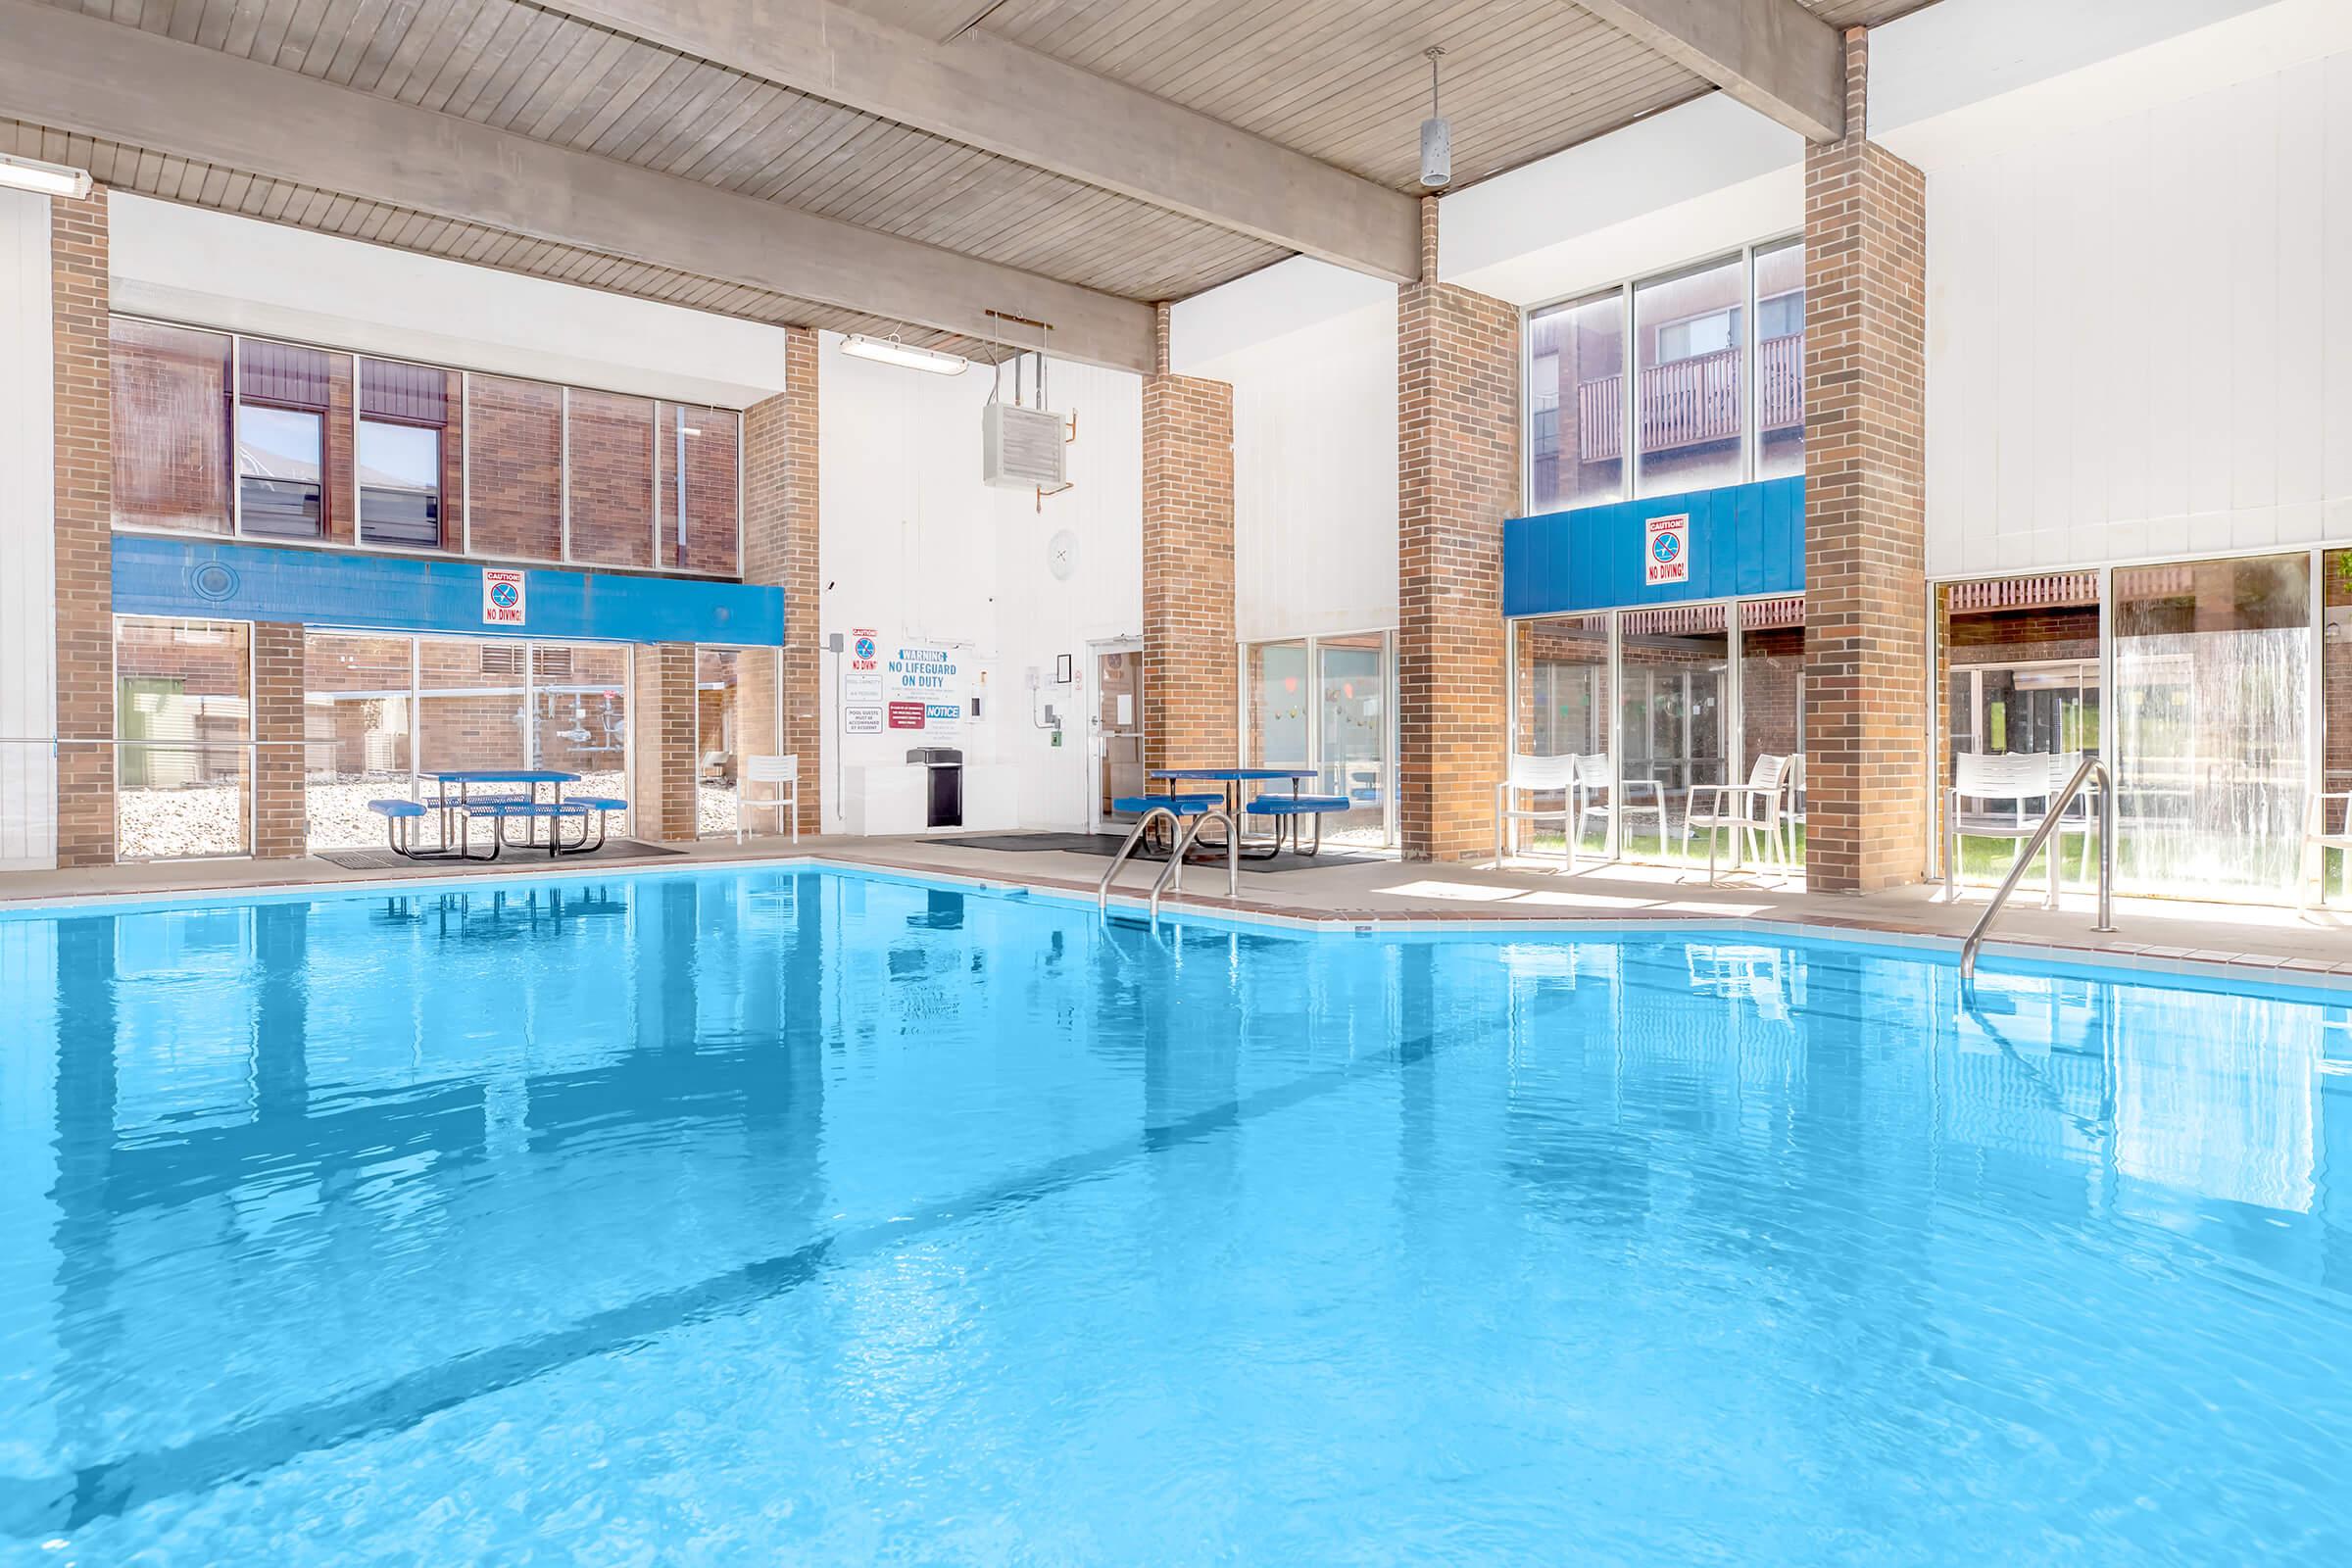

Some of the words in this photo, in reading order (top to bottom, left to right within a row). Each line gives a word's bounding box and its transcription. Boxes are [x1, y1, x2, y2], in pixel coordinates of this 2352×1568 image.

[1650, 520, 1684, 531] CAUTION!
[488, 572, 520, 581] CAUTION!
[1649, 565, 1658, 580] NO
[1660, 563, 1684, 578] DIVING!
[487, 608, 496, 620] NO
[499, 609, 521, 621] DIVING!
[903, 649, 943, 662] WARNING
[853, 660, 860, 670] NO
[889, 661, 903, 672] NO
[906, 662, 956, 674] LIFEGUARD
[902, 674, 915, 687] ON
[918, 675, 944, 688] DUTY
[927, 706, 959, 717] NOTICE
